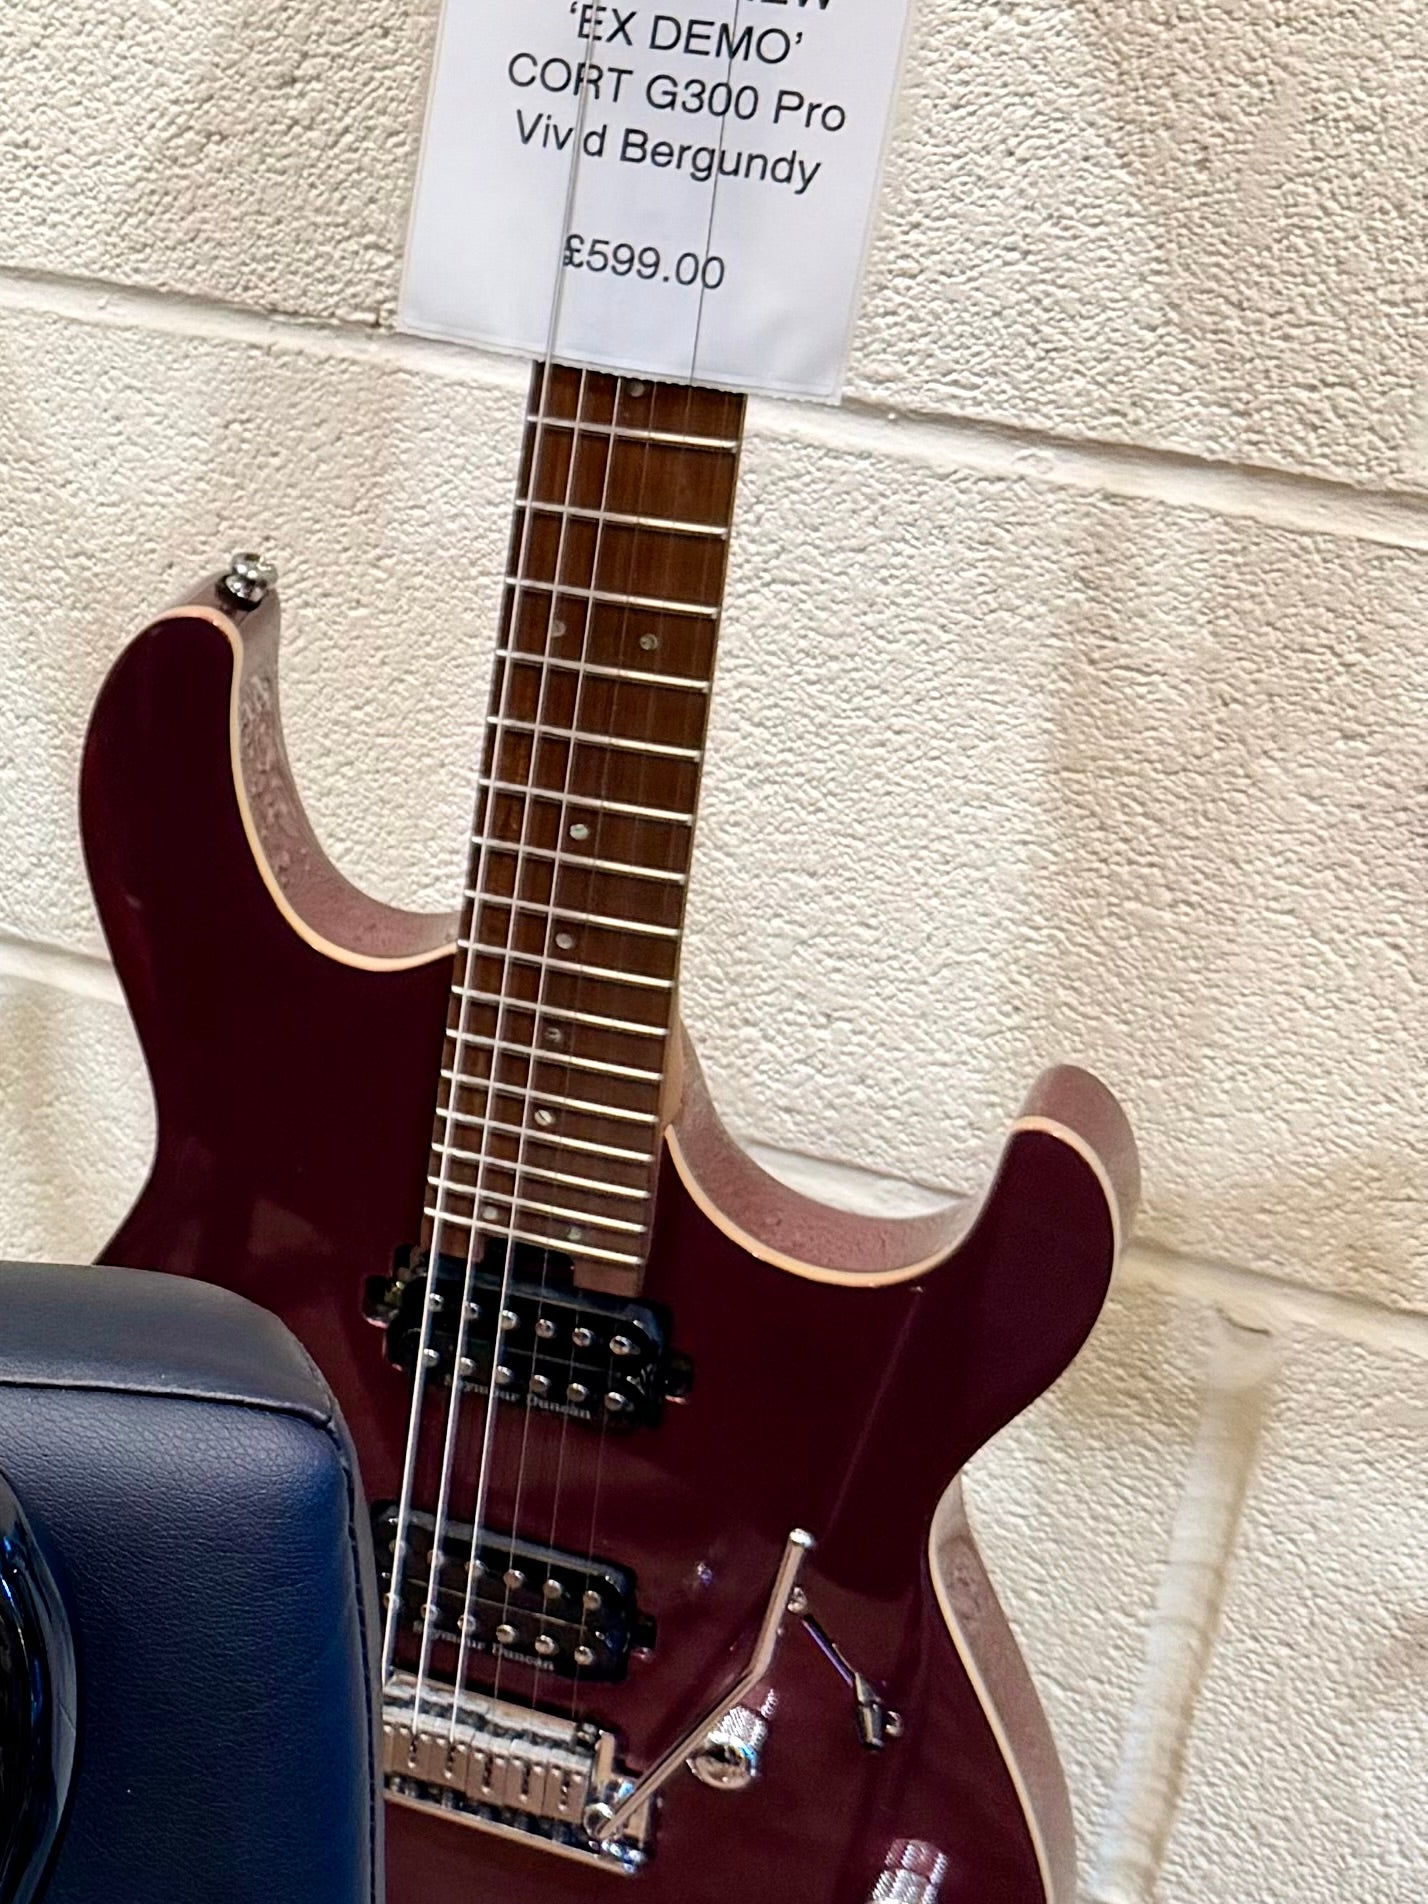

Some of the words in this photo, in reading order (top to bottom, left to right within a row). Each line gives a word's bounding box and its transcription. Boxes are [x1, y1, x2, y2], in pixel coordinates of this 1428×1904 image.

[507, 52, 632, 102] CORT
[646, 75, 757, 120] G300
[774, 89, 846, 133] Pro
[516, 110, 606, 159] Vivd
[621, 127, 821, 195] Bergundy
[564, 233, 725, 290] £599.00
